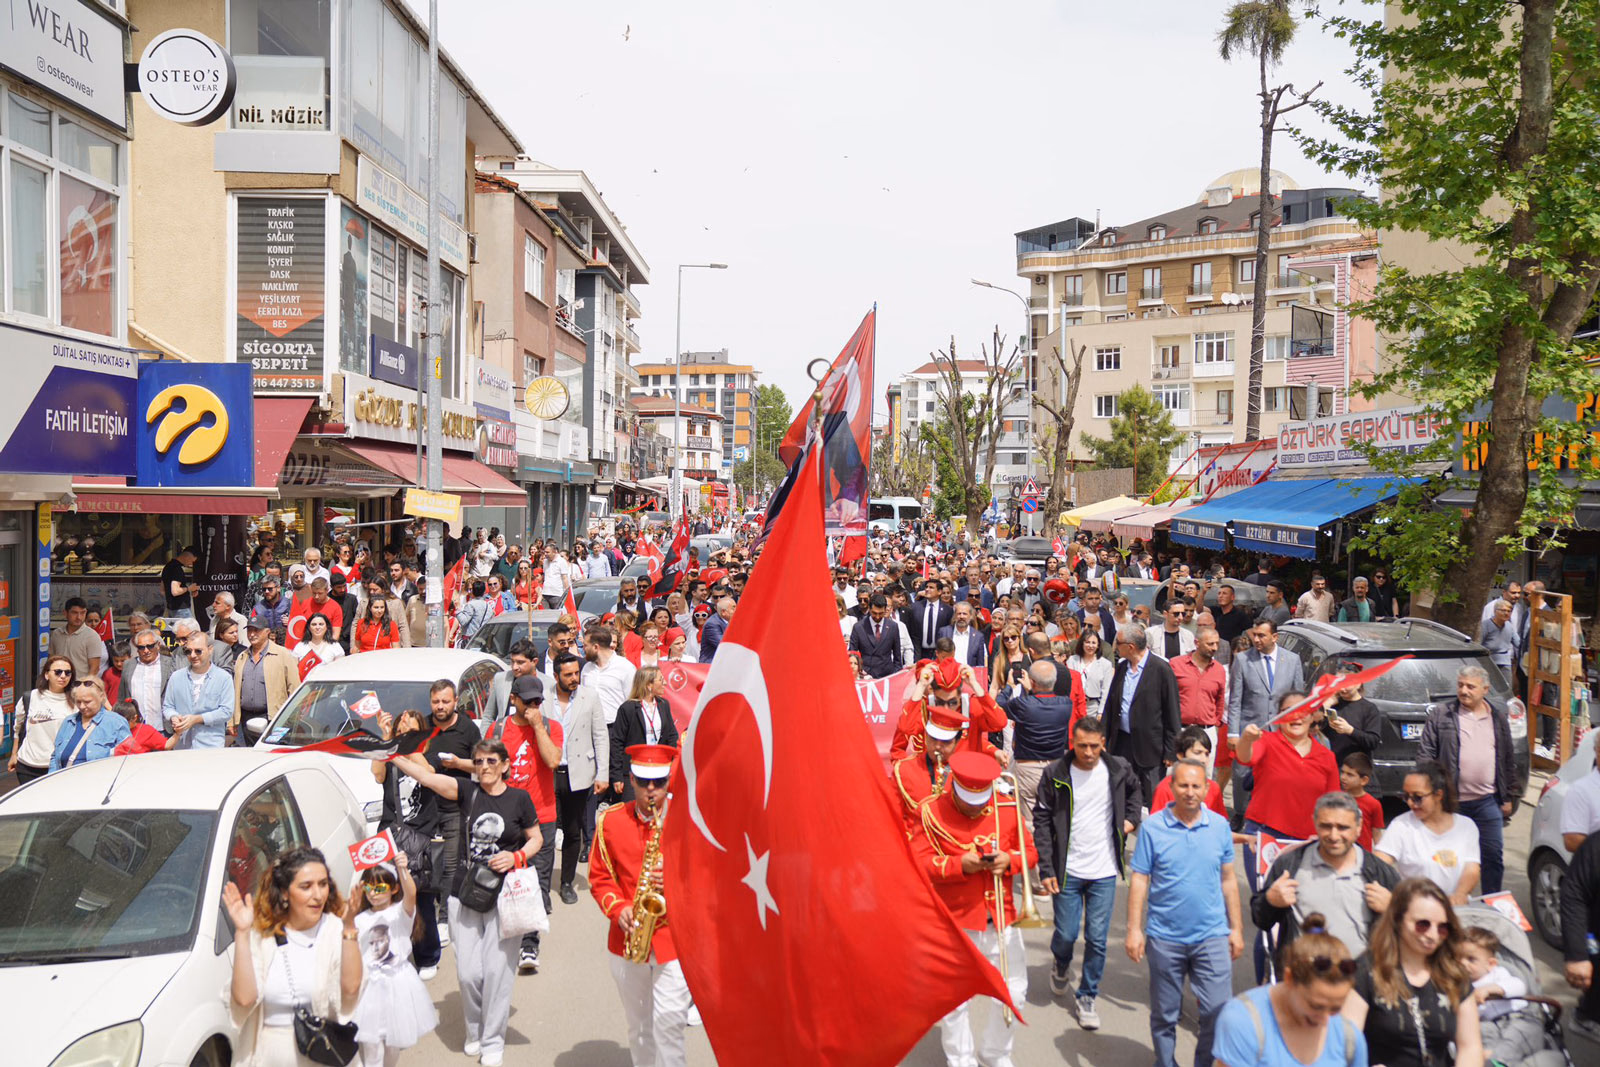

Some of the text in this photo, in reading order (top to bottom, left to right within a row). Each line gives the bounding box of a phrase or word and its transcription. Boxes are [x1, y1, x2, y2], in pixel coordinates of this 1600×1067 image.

[27, 0, 94, 63] WEAR
[47, 63, 95, 98] osteoswear
[239, 105, 323, 125] NİL MÜZİK
[267, 207, 294, 217] TRAFİK
[268, 221, 294, 229] KASKO
[267, 232, 294, 242] SAĞLIK
[267, 245, 293, 254] KONUT
[268, 257, 293, 267] İŞYERİ
[270, 270, 290, 279] DASK
[262, 281, 298, 291] NAKLİYAT
[259, 294, 300, 304] YEŞİLKART
[258, 306, 302, 316] FERDİ KAZA
[272, 319, 287, 328] BES
[243, 340, 316, 355] SİGORTA
[53, 344, 78, 360] DİJİTAL
[79, 349, 97, 364] SATIŞ
[98, 354, 124, 368] NOKTASI
[252, 356, 308, 370] SEPETİ
[269, 379, 288, 388] 447
[290, 379, 303, 388] 35
[304, 379, 315, 388] 13
[354, 386, 404, 428] GÖZDE
[46, 406, 128, 440] FATİH İLETİŞİM
[1280, 422, 1337, 451] ÖZTÜRK
[1002, 474, 1022, 482] Garanti
[1177, 521, 1195, 535] ÖZTÜRK
[1245, 526, 1299, 544] ÖZTÜRK BALIK
[211, 573, 238, 581] GÖZDE
[871, 714, 886, 723] VE
[1408, 725, 1419, 735] 34
